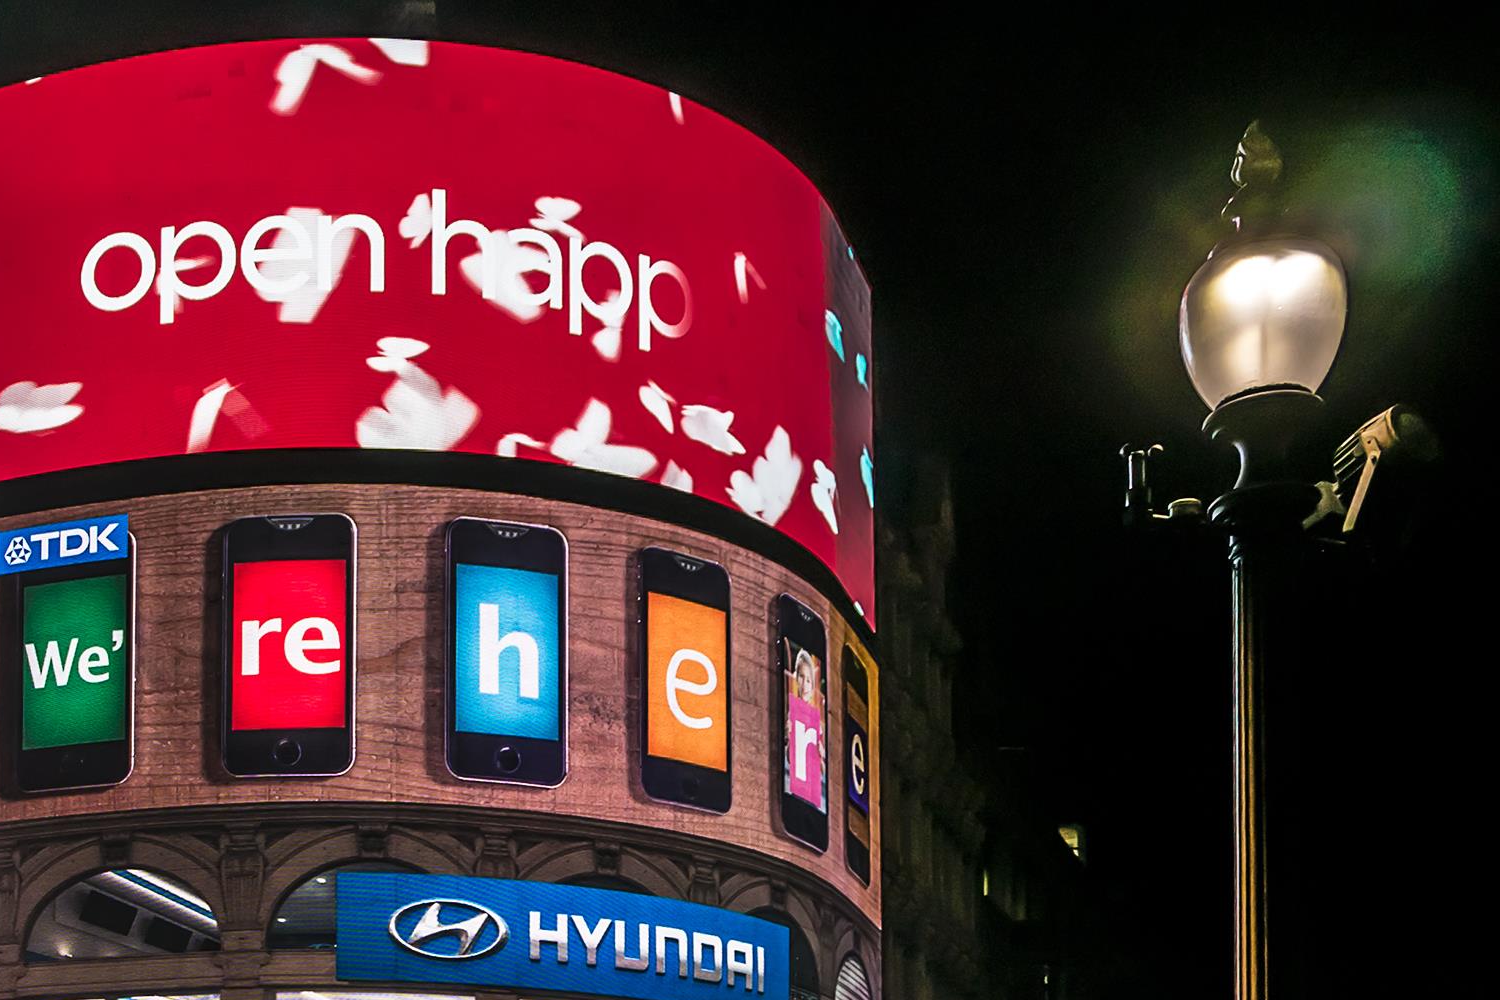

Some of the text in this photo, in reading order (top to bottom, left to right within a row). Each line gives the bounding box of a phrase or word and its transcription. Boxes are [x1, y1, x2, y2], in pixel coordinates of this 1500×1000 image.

[81, 188, 692, 351] open happ
[31, 522, 120, 560] TDK
[529, 911, 765, 993] HYUNDAI
